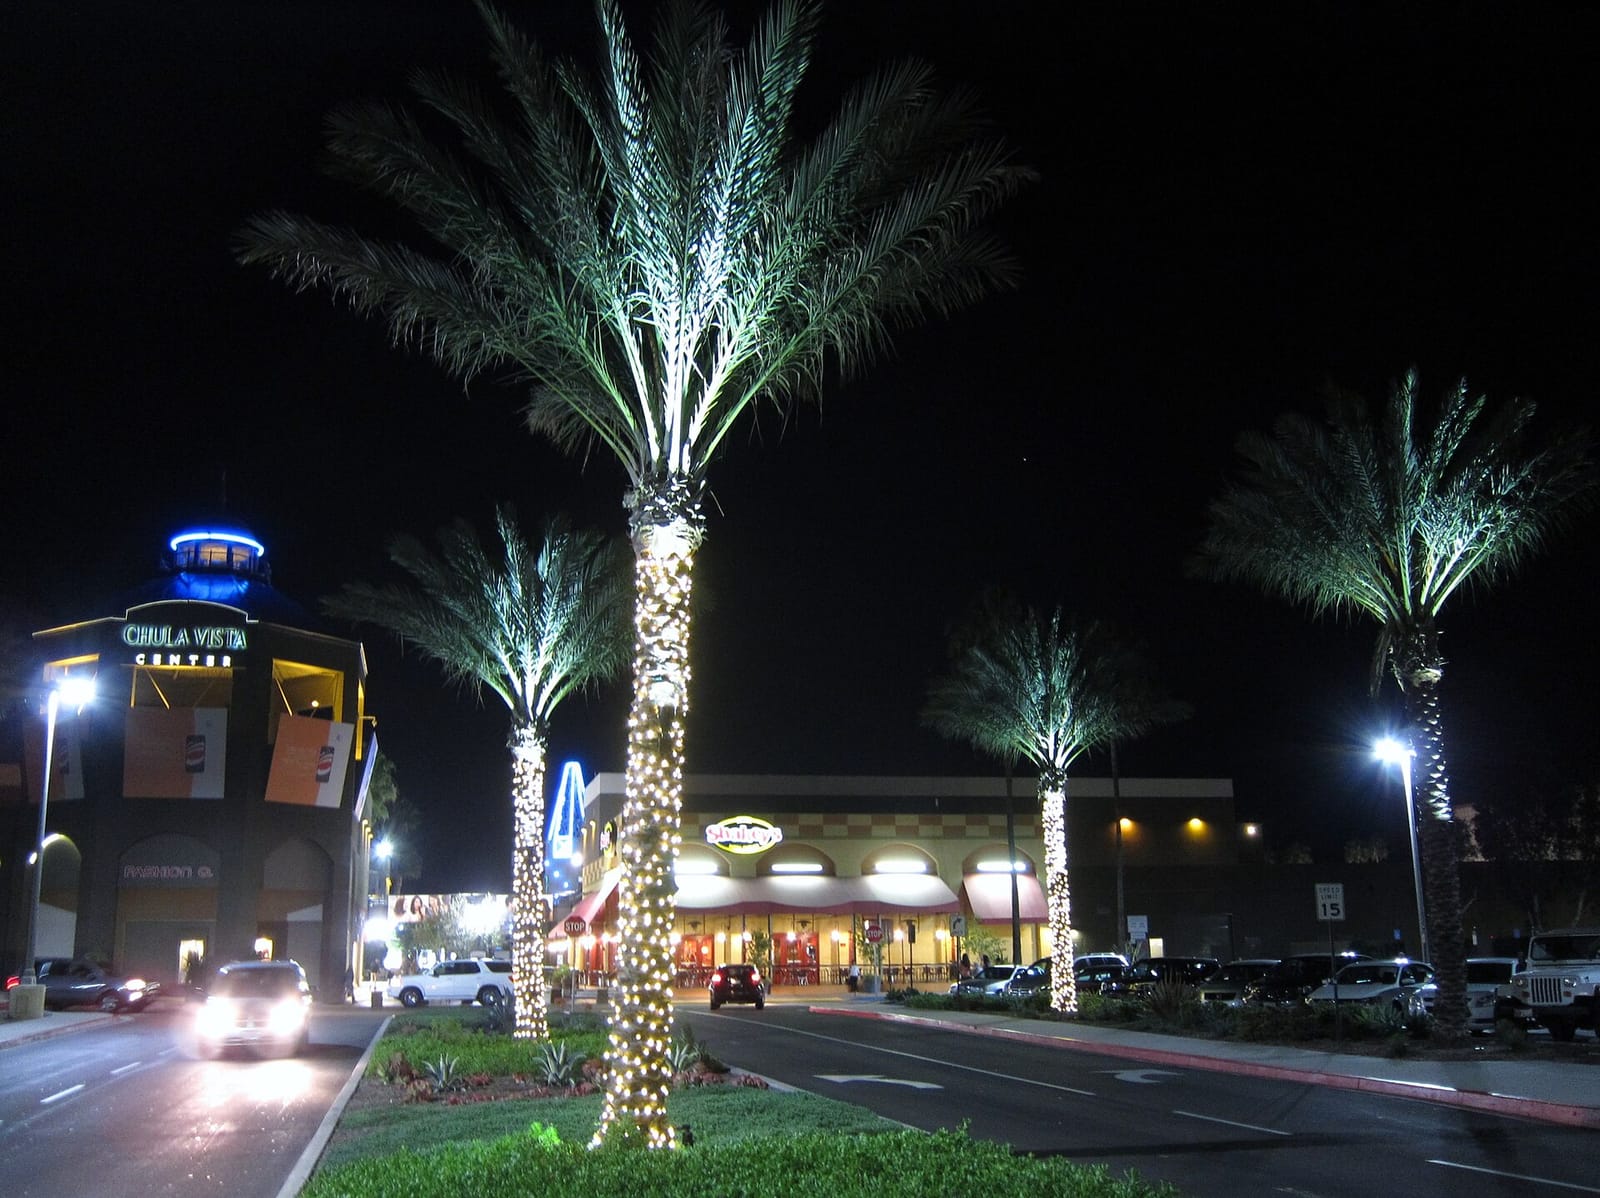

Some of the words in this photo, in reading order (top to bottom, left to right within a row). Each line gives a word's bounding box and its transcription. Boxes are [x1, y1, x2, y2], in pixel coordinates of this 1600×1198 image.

[124, 624, 189, 647] CHULA
[193, 626, 247, 649] VISTA
[136, 653, 232, 667] CENTER
[1322, 903, 1341, 917] 15
[565, 921, 585, 932] STOP
[867, 930, 882, 938] STOP
